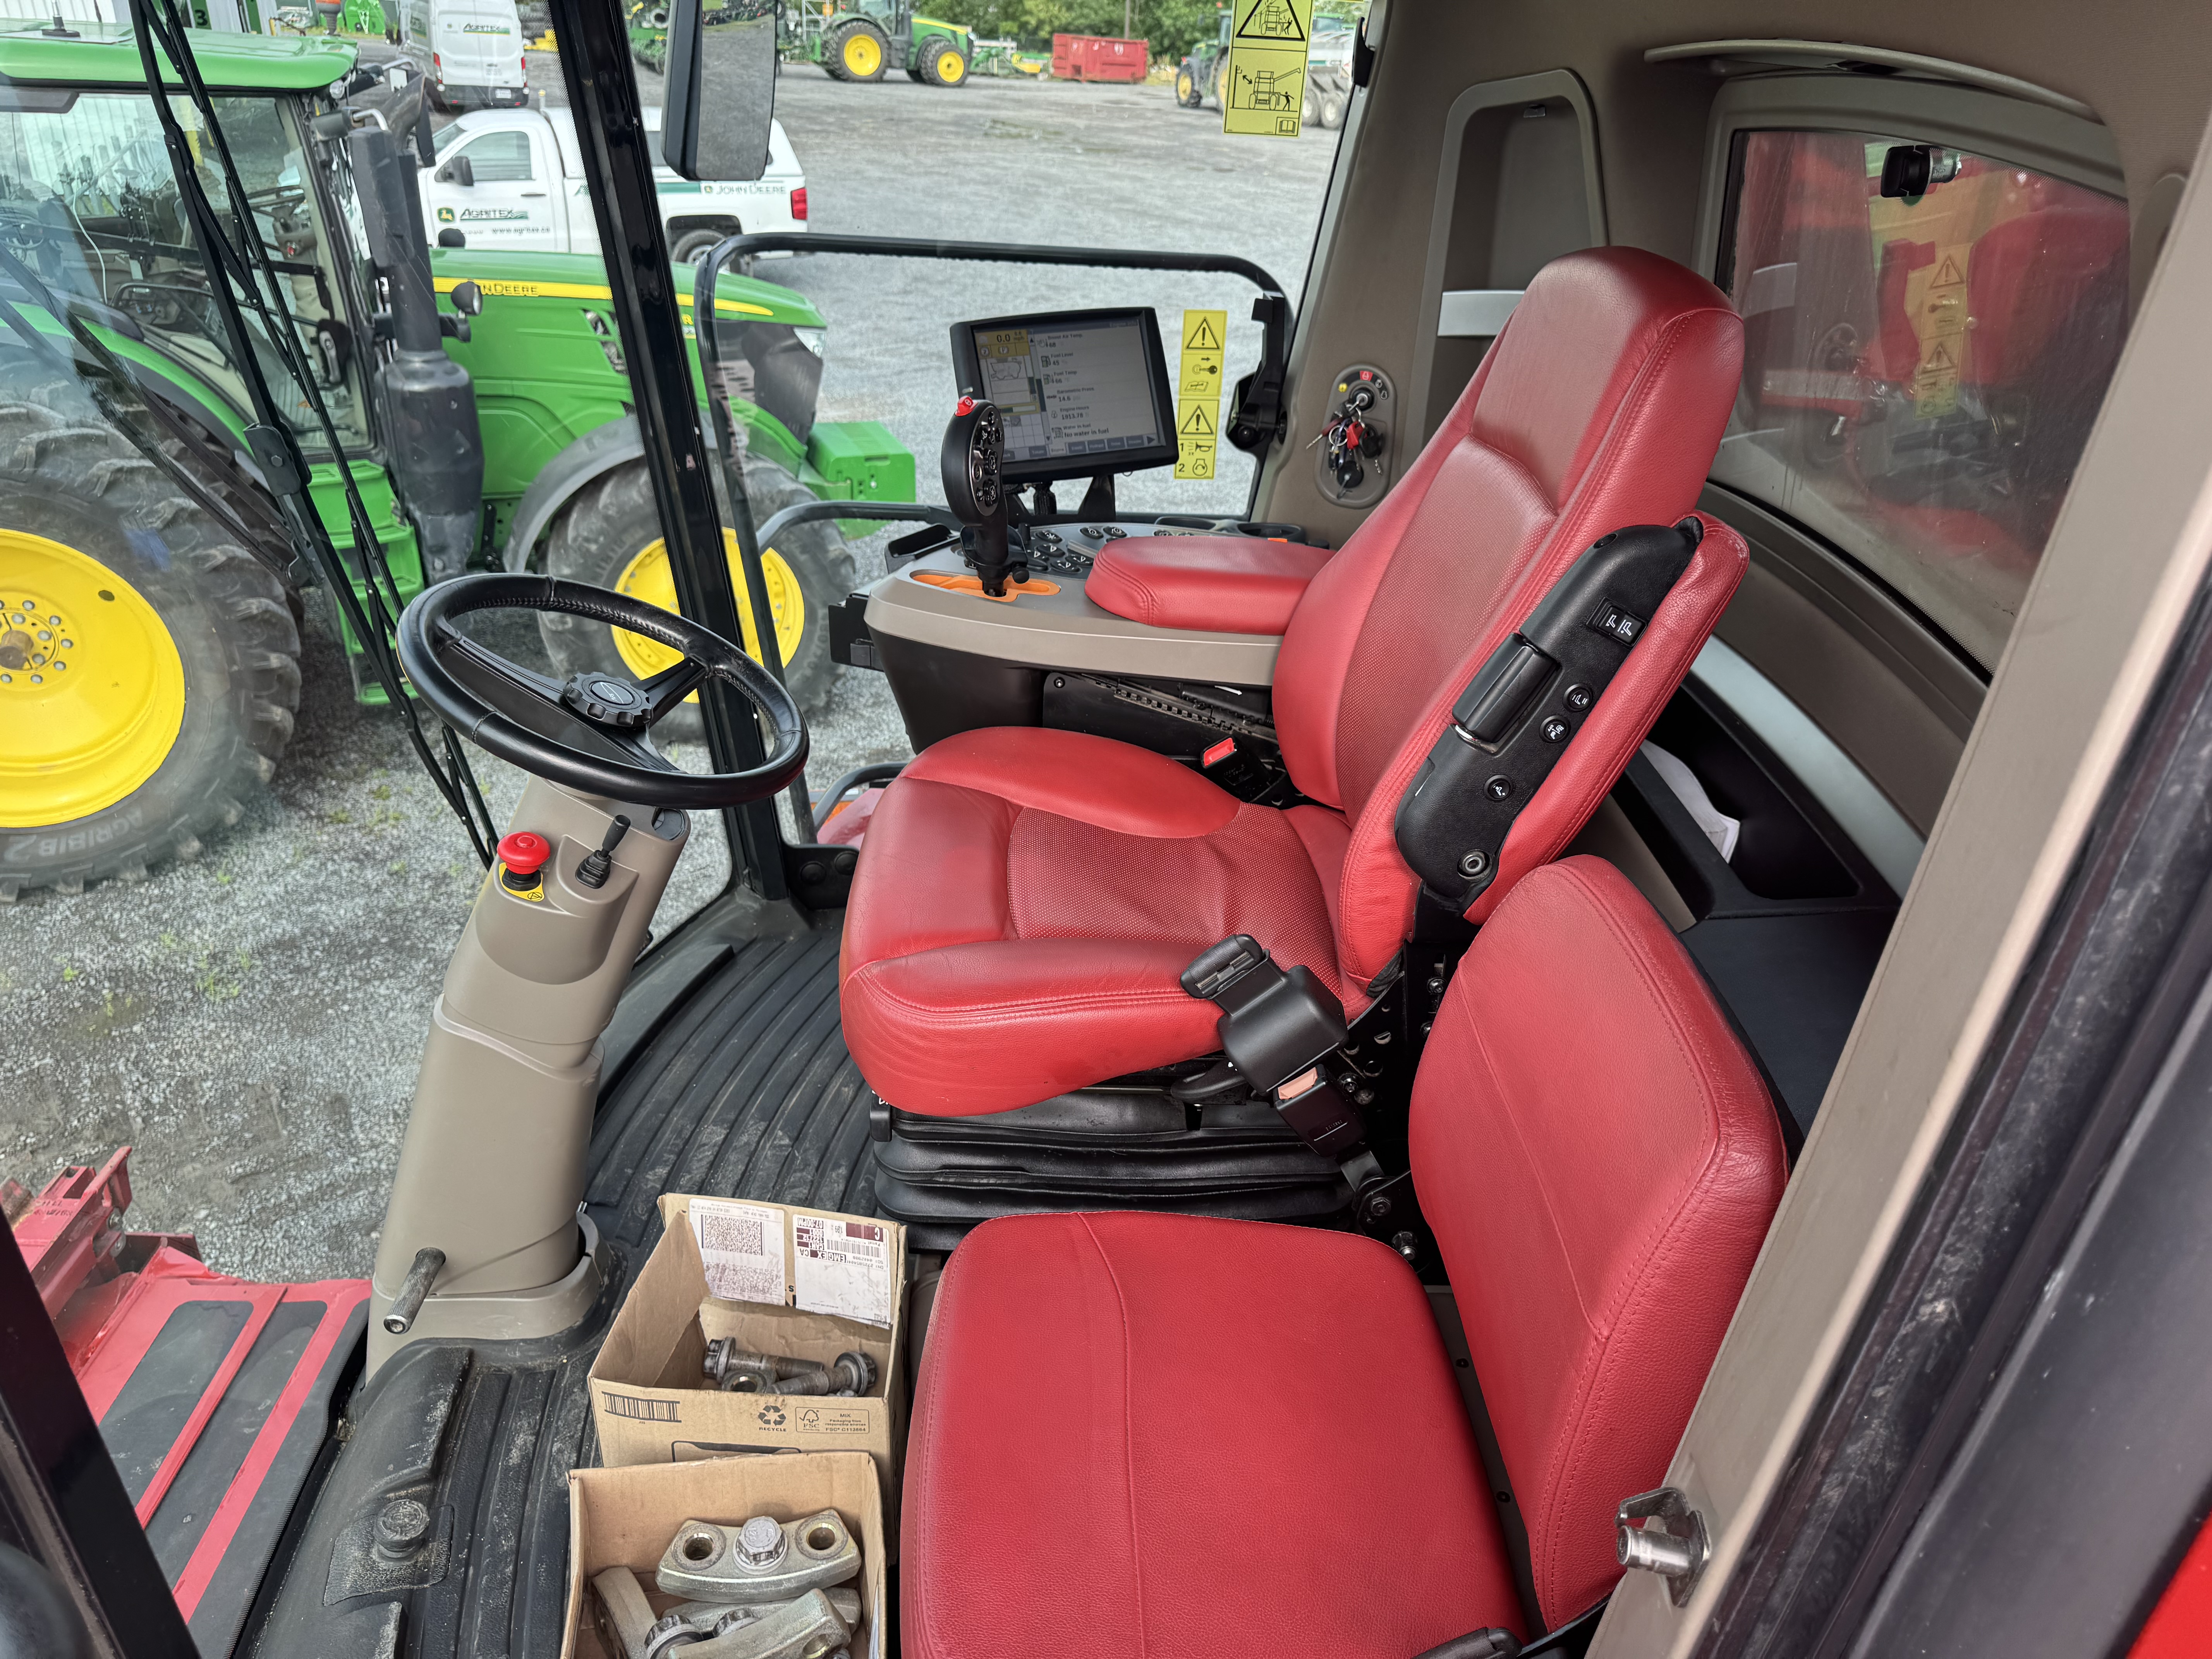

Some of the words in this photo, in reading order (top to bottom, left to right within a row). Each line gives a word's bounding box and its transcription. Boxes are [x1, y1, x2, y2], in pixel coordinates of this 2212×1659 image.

[194, 9, 208, 26] 3
[460, 208, 514, 218] AGRITEX
[495, 283, 538, 295] DEERE
[996, 334, 1010, 343] 0.0
[1180, 443, 1184, 452] 1
[1179, 463, 1185, 472] 2
[798, 1218, 824, 1230] 07:00PM
[874, 1227, 880, 1240] C
[799, 1248, 809, 1257] CA
[817, 1251, 827, 1260] EX
[828, 1252, 845, 1262] EMG
